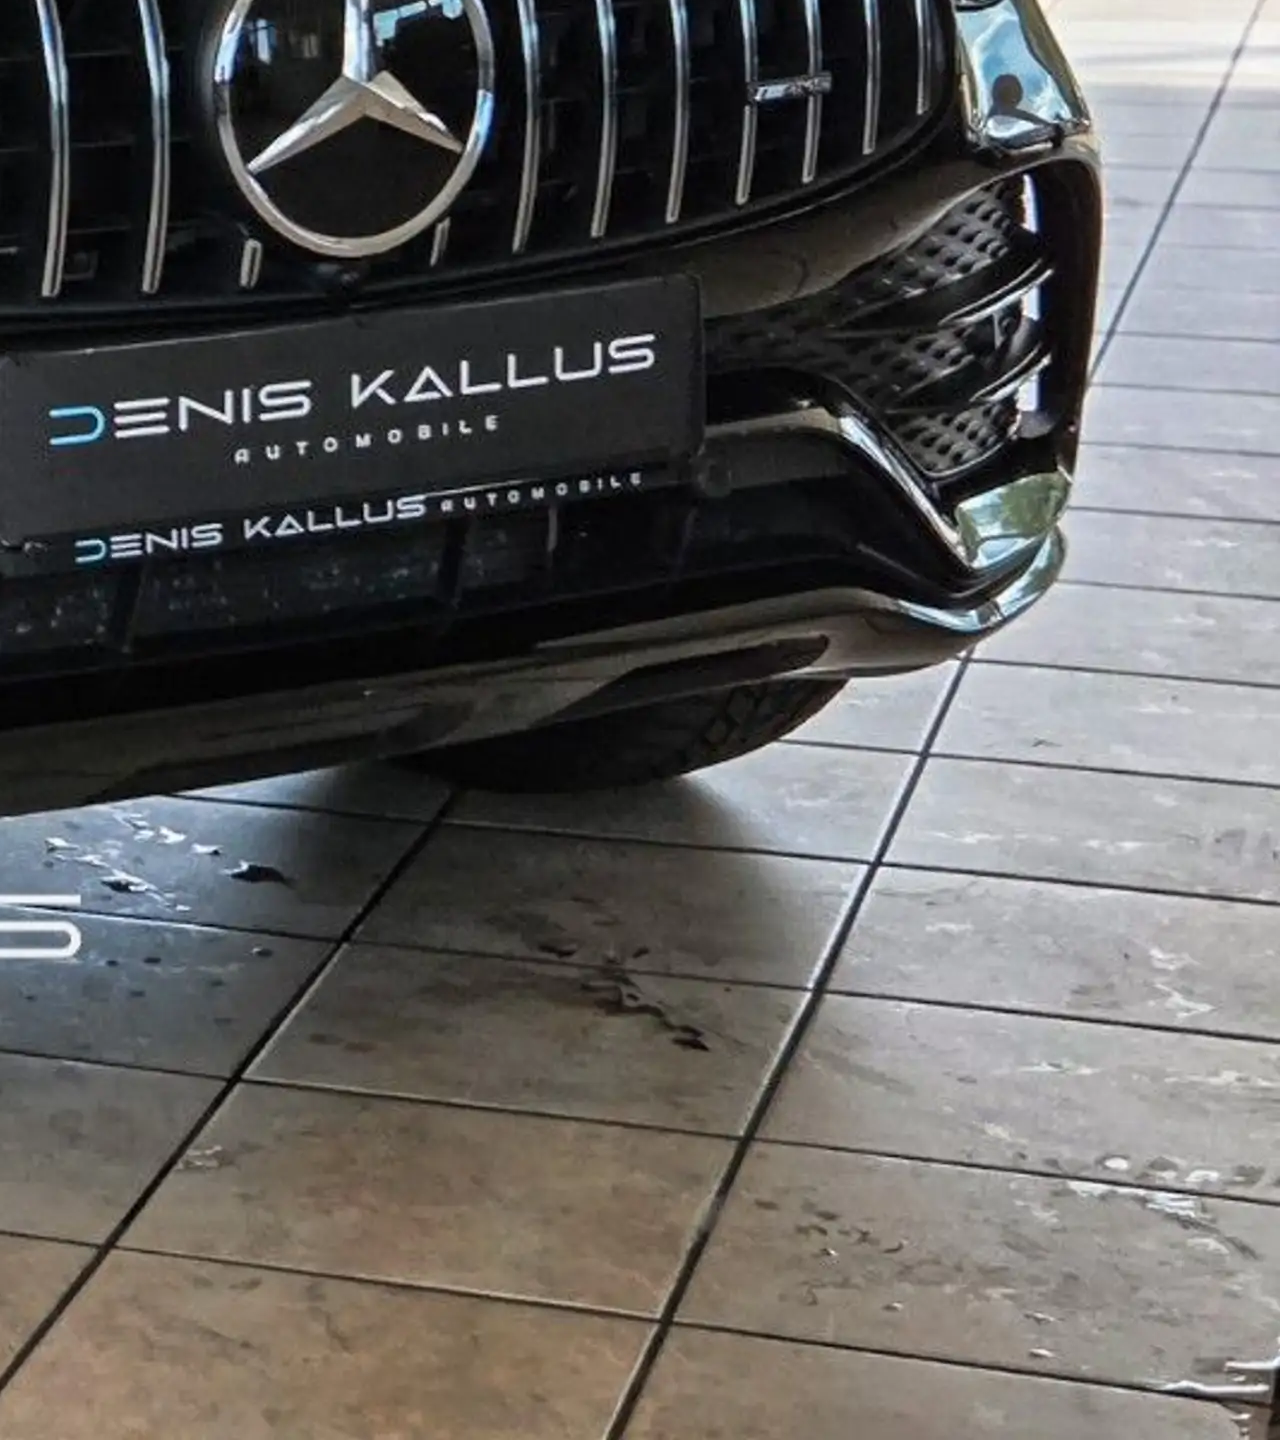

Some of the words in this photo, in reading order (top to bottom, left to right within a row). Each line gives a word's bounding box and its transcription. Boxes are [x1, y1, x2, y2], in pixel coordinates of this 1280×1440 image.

[48, 379, 313, 446] DENIS
[350, 333, 656, 410] KALLUS
[233, 413, 501, 465] AUTOMOBILE
[74, 521, 224, 564] DENIS
[242, 493, 428, 540] KALLUS
[440, 471, 642, 513] AUTOMOBILE
